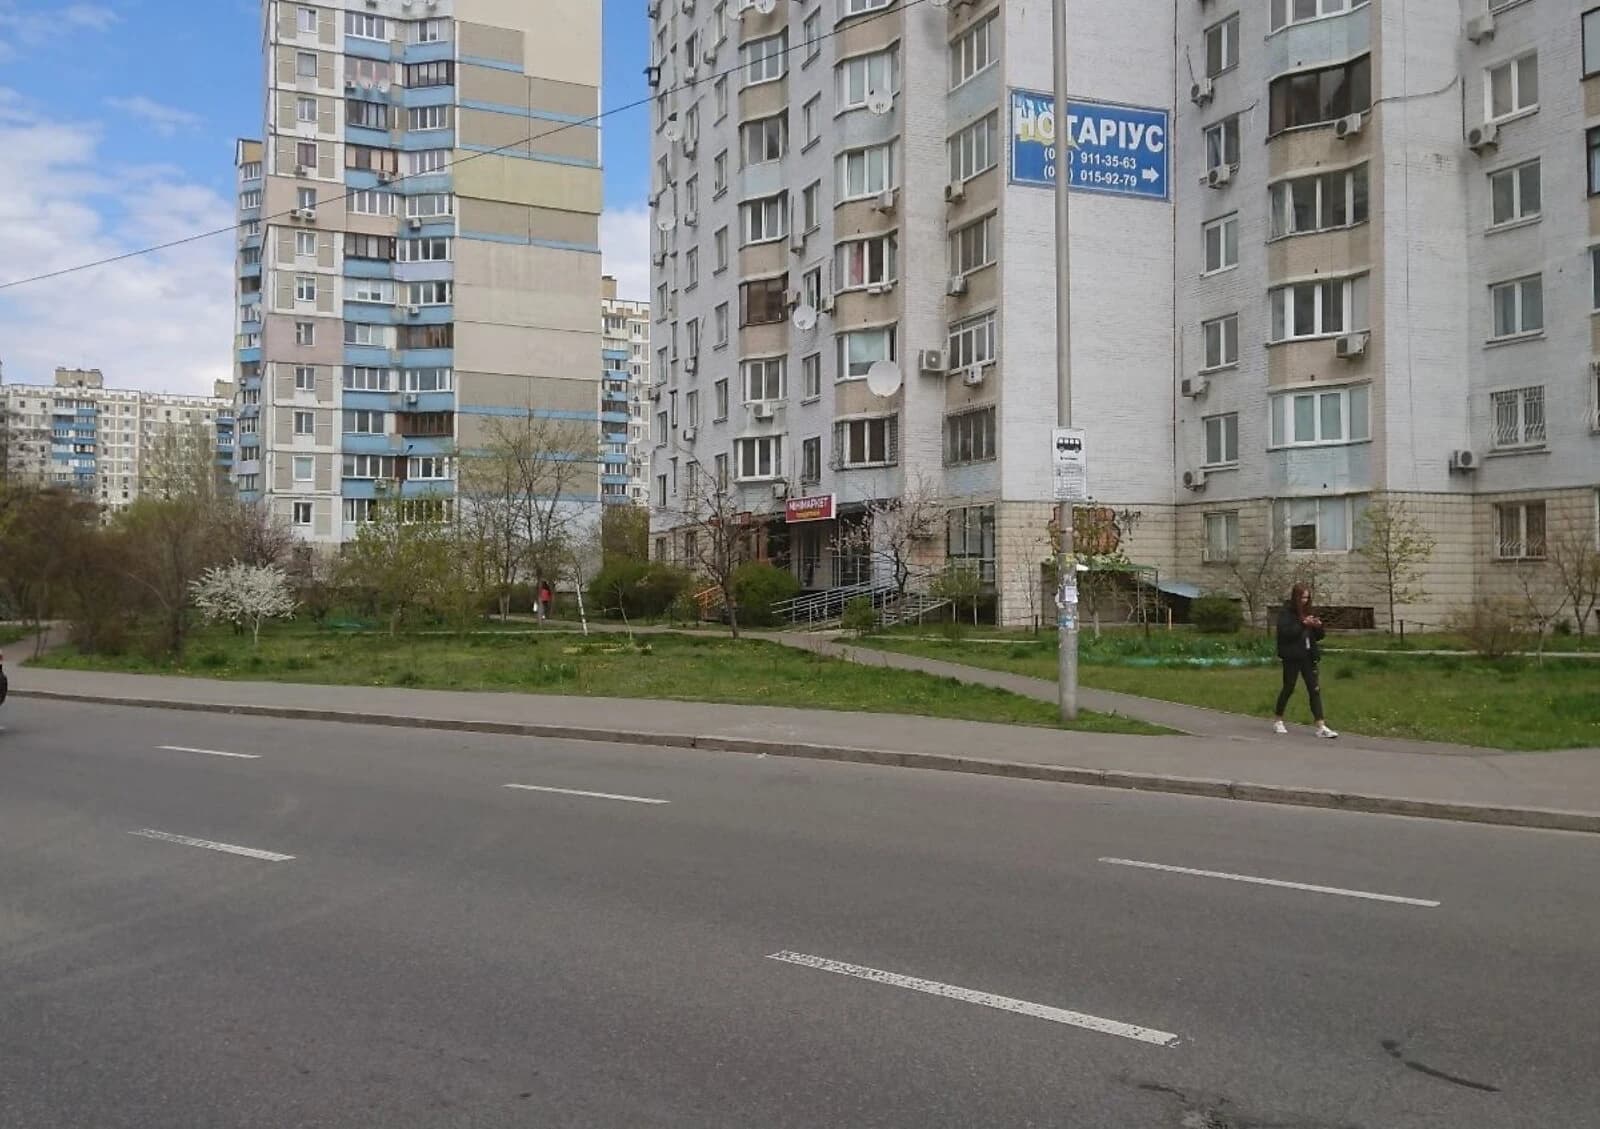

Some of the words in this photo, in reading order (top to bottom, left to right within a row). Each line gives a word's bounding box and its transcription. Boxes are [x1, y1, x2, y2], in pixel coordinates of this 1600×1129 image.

[1015, 105, 1164, 153] НОТАРІУС
[1080, 152, 1137, 170] 911-35-63
[1080, 170, 1137, 187] 015-92-79
